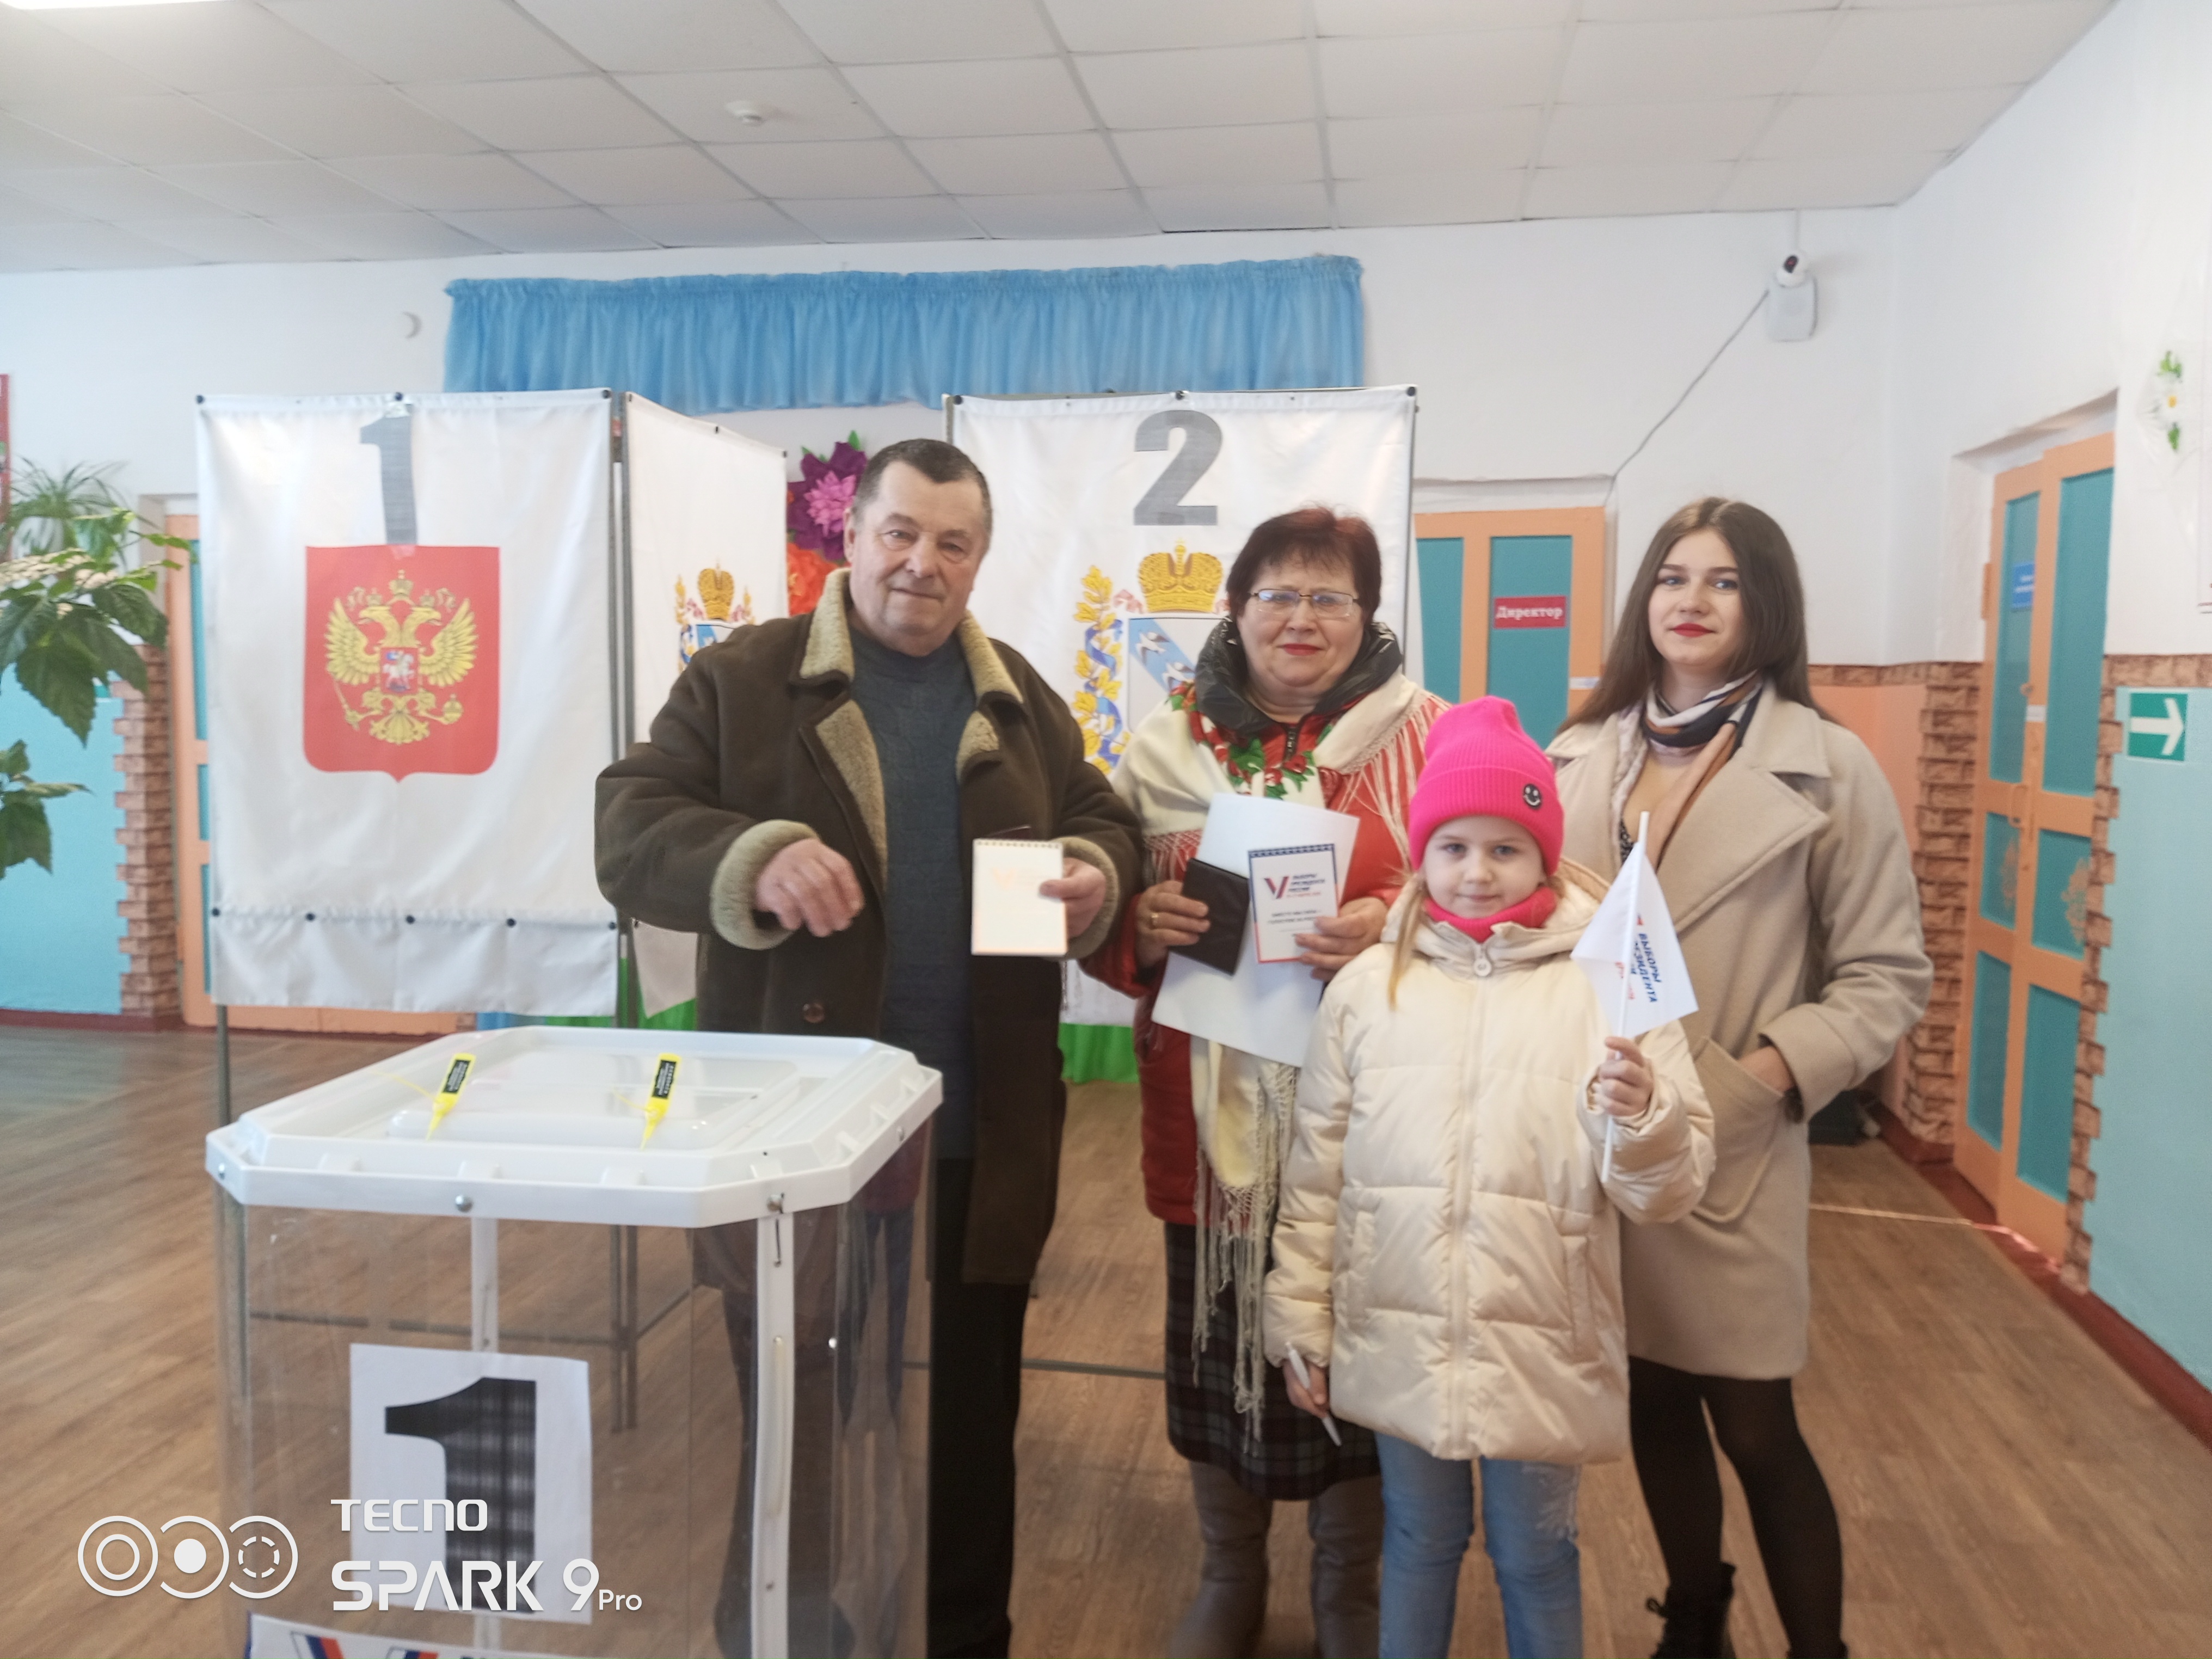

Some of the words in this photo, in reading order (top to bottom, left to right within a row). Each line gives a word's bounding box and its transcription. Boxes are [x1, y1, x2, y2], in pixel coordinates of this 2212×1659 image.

[360, 404, 417, 545] 1
[1134, 410, 1223, 526] 2
[1496, 605, 1563, 620] Директор
[1639, 933, 1662, 982] ВЫБОРЫ
[385, 1377, 536, 1614] 1
